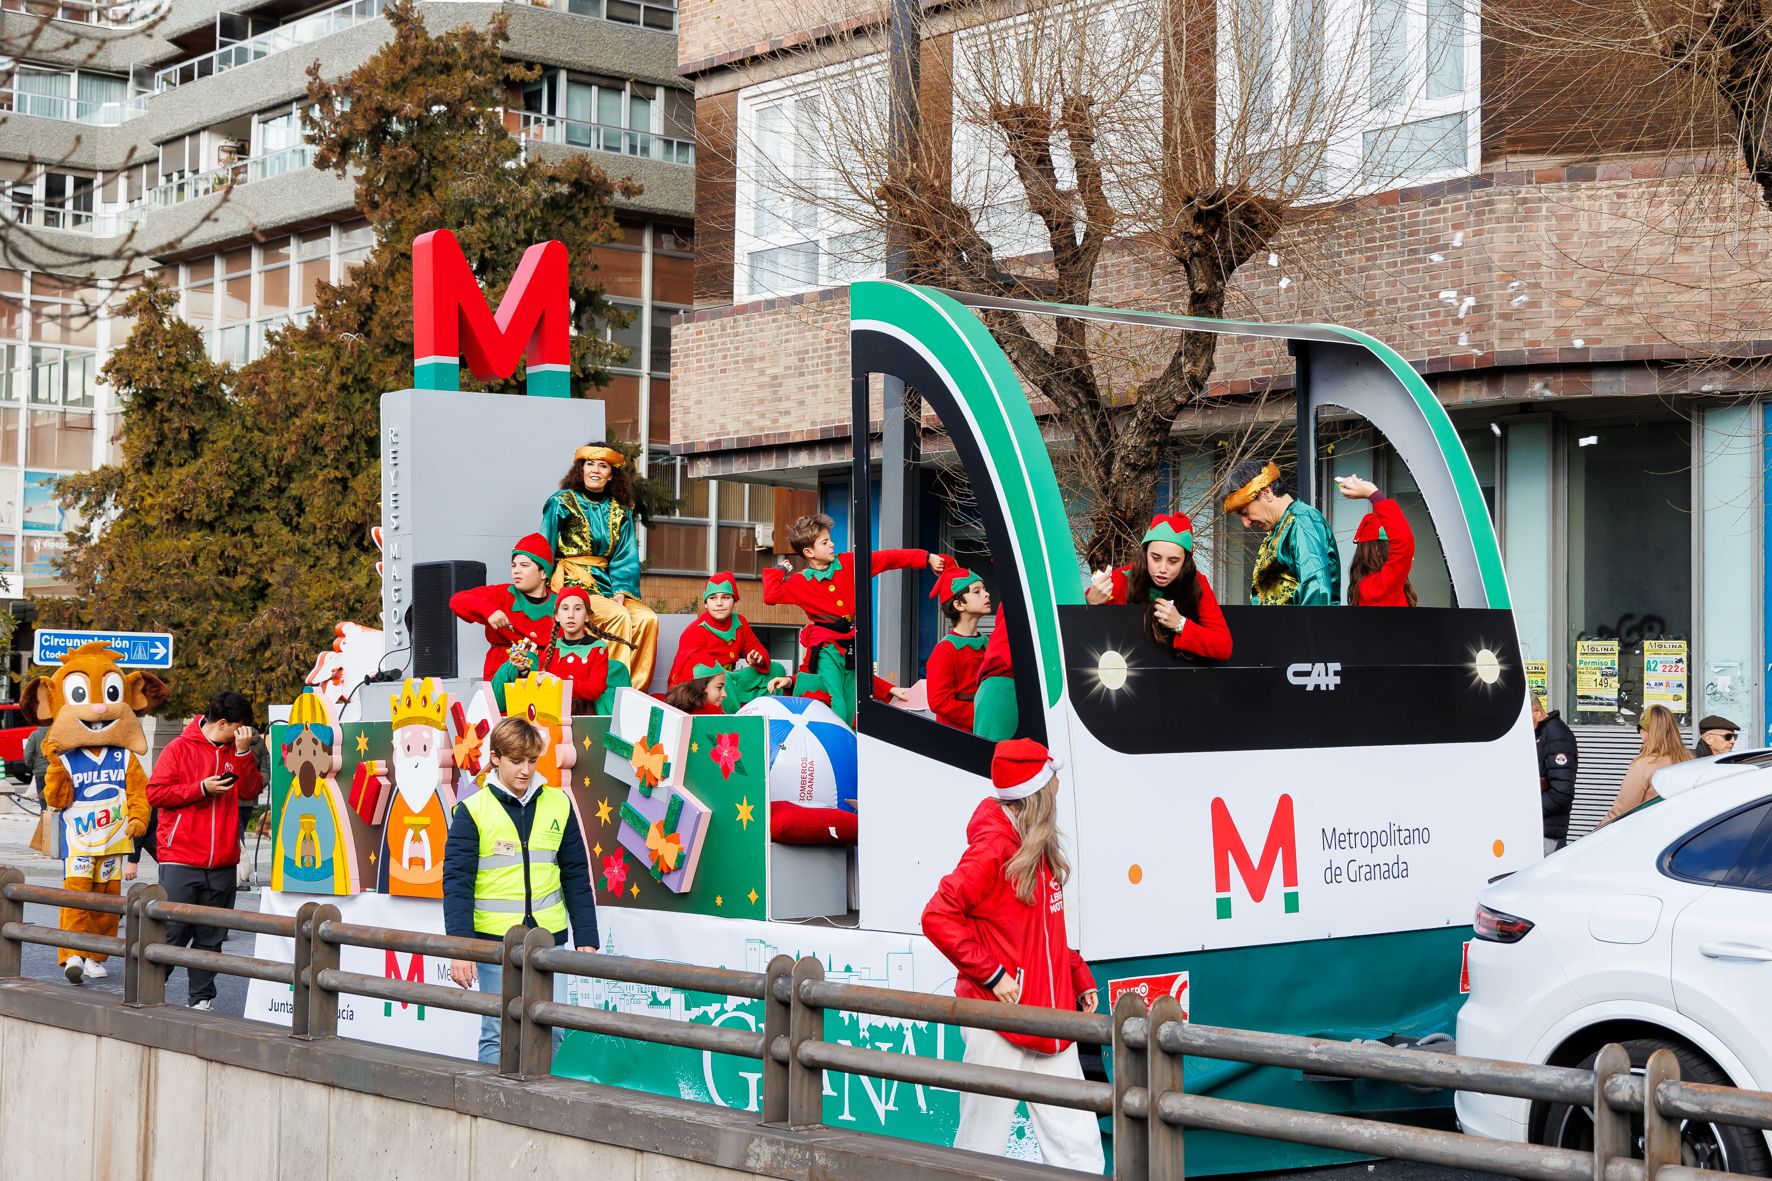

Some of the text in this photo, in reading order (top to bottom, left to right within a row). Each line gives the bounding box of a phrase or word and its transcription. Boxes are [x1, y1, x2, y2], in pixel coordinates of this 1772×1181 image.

[412, 229, 571, 398] M
[388, 427, 402, 646] REYES MAGOS
[1579, 659, 1609, 667] Permiso
[1581, 644, 1615, 653] MOLINA
[1286, 662, 1342, 691] CAF
[1646, 659, 1659, 672] A2
[113, 751, 123, 762] 9
[72, 768, 126, 788] PULEVA
[806, 760, 815, 801] GRANADA
[73, 804, 123, 836] Max
[1321, 822, 1431, 854] Metropolitano
[1210, 793, 1300, 921] M
[1323, 854, 1410, 884] de Granada
[268, 998, 294, 1014] Junta
